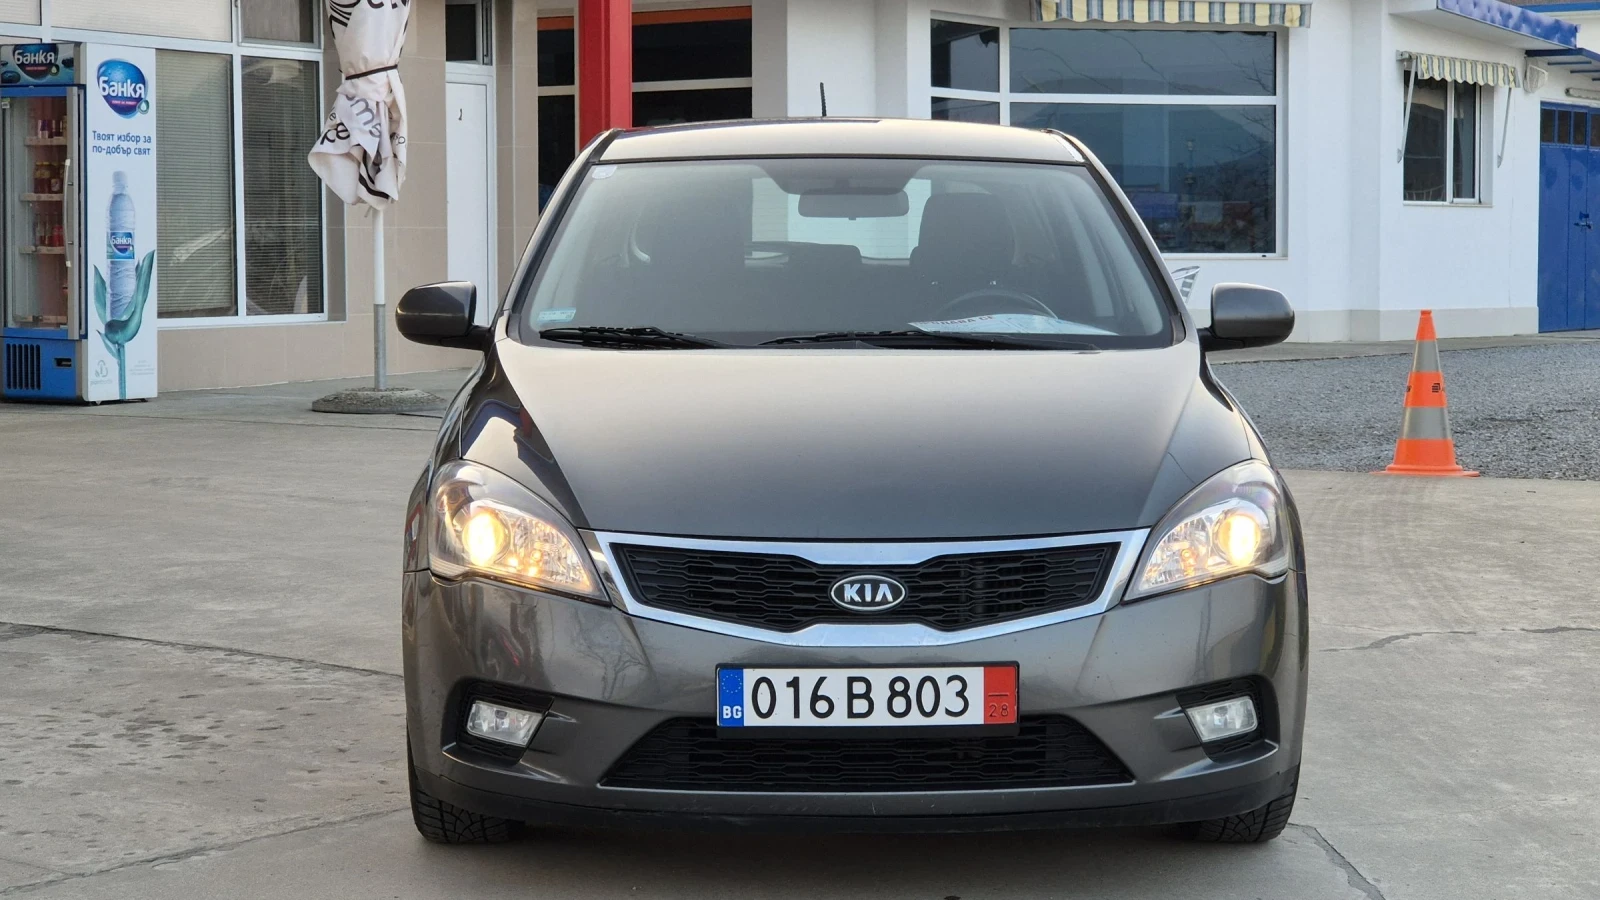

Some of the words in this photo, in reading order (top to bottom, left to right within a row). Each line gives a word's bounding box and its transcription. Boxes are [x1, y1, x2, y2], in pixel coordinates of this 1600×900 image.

[92, 130, 115, 141] Твоят
[117, 132, 140, 145] избор
[143, 135, 152, 144] за
[92, 145, 132, 157] по-добър
[133, 147, 151, 156] свят
[843, 583, 894, 603] KIA
[722, 705, 742, 719] BG
[988, 703, 1009, 718] 28
